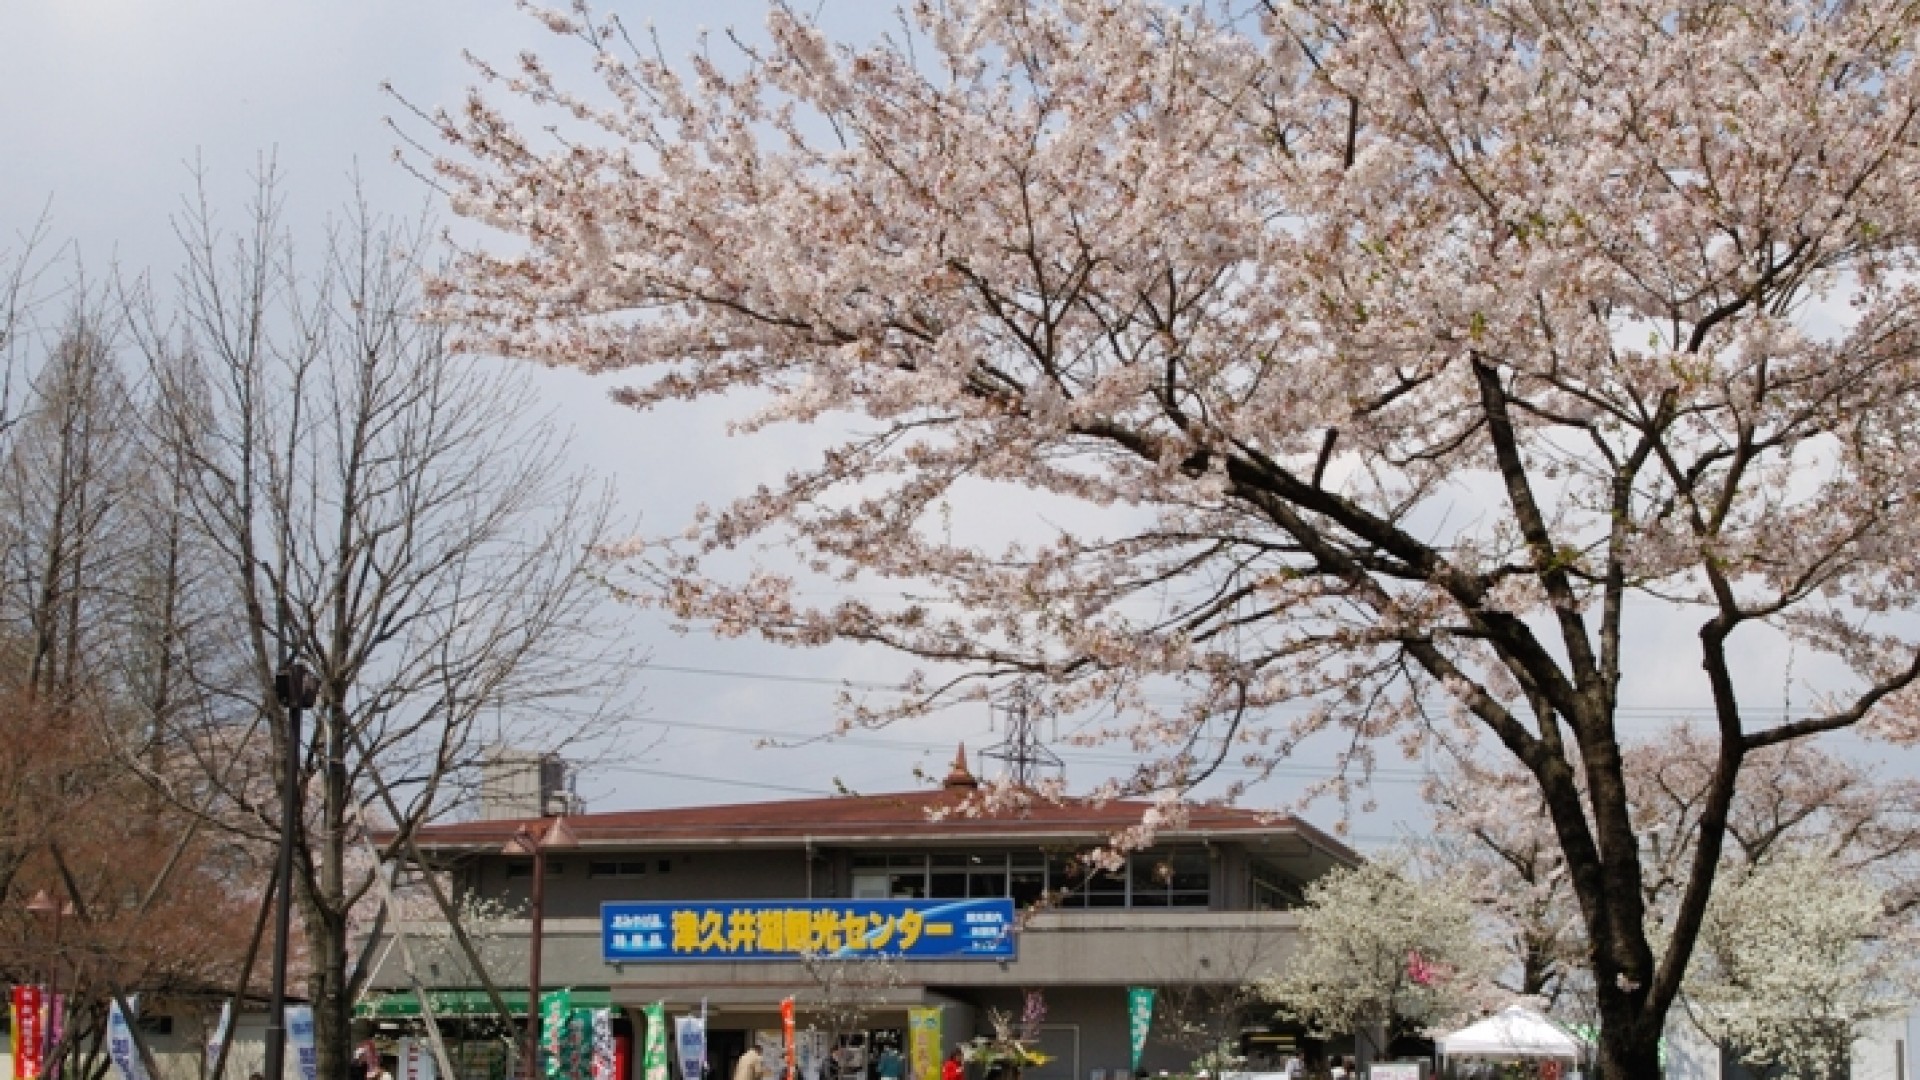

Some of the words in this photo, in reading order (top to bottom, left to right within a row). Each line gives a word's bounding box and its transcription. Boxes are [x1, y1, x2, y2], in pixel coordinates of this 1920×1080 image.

[671, 908, 954, 952] 津久井湖観光センター
